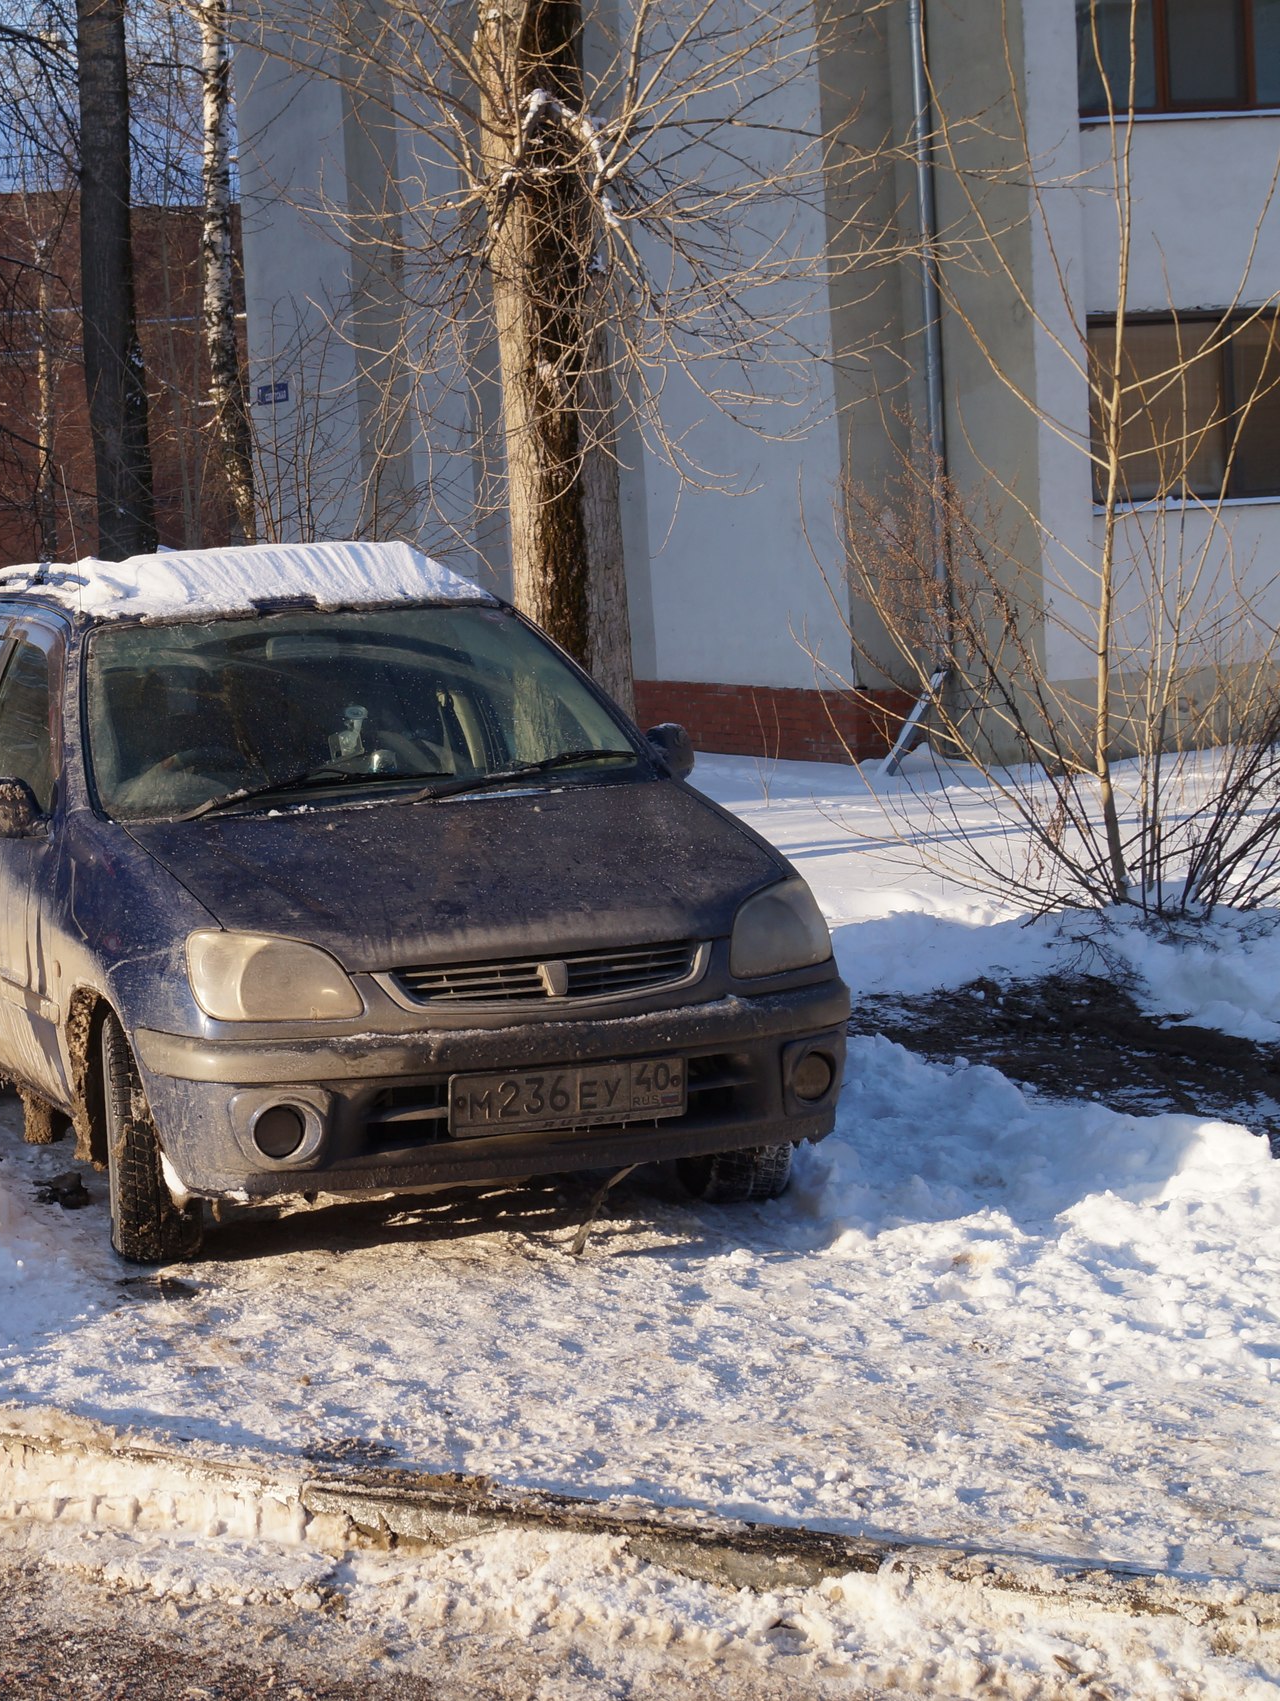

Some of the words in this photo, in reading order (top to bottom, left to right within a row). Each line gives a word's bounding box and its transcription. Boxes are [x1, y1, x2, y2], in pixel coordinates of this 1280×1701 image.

[635, 1063, 670, 1092] 40
[632, 1094, 660, 1107] RUS
[543, 1113, 632, 1129] RUSSIA
